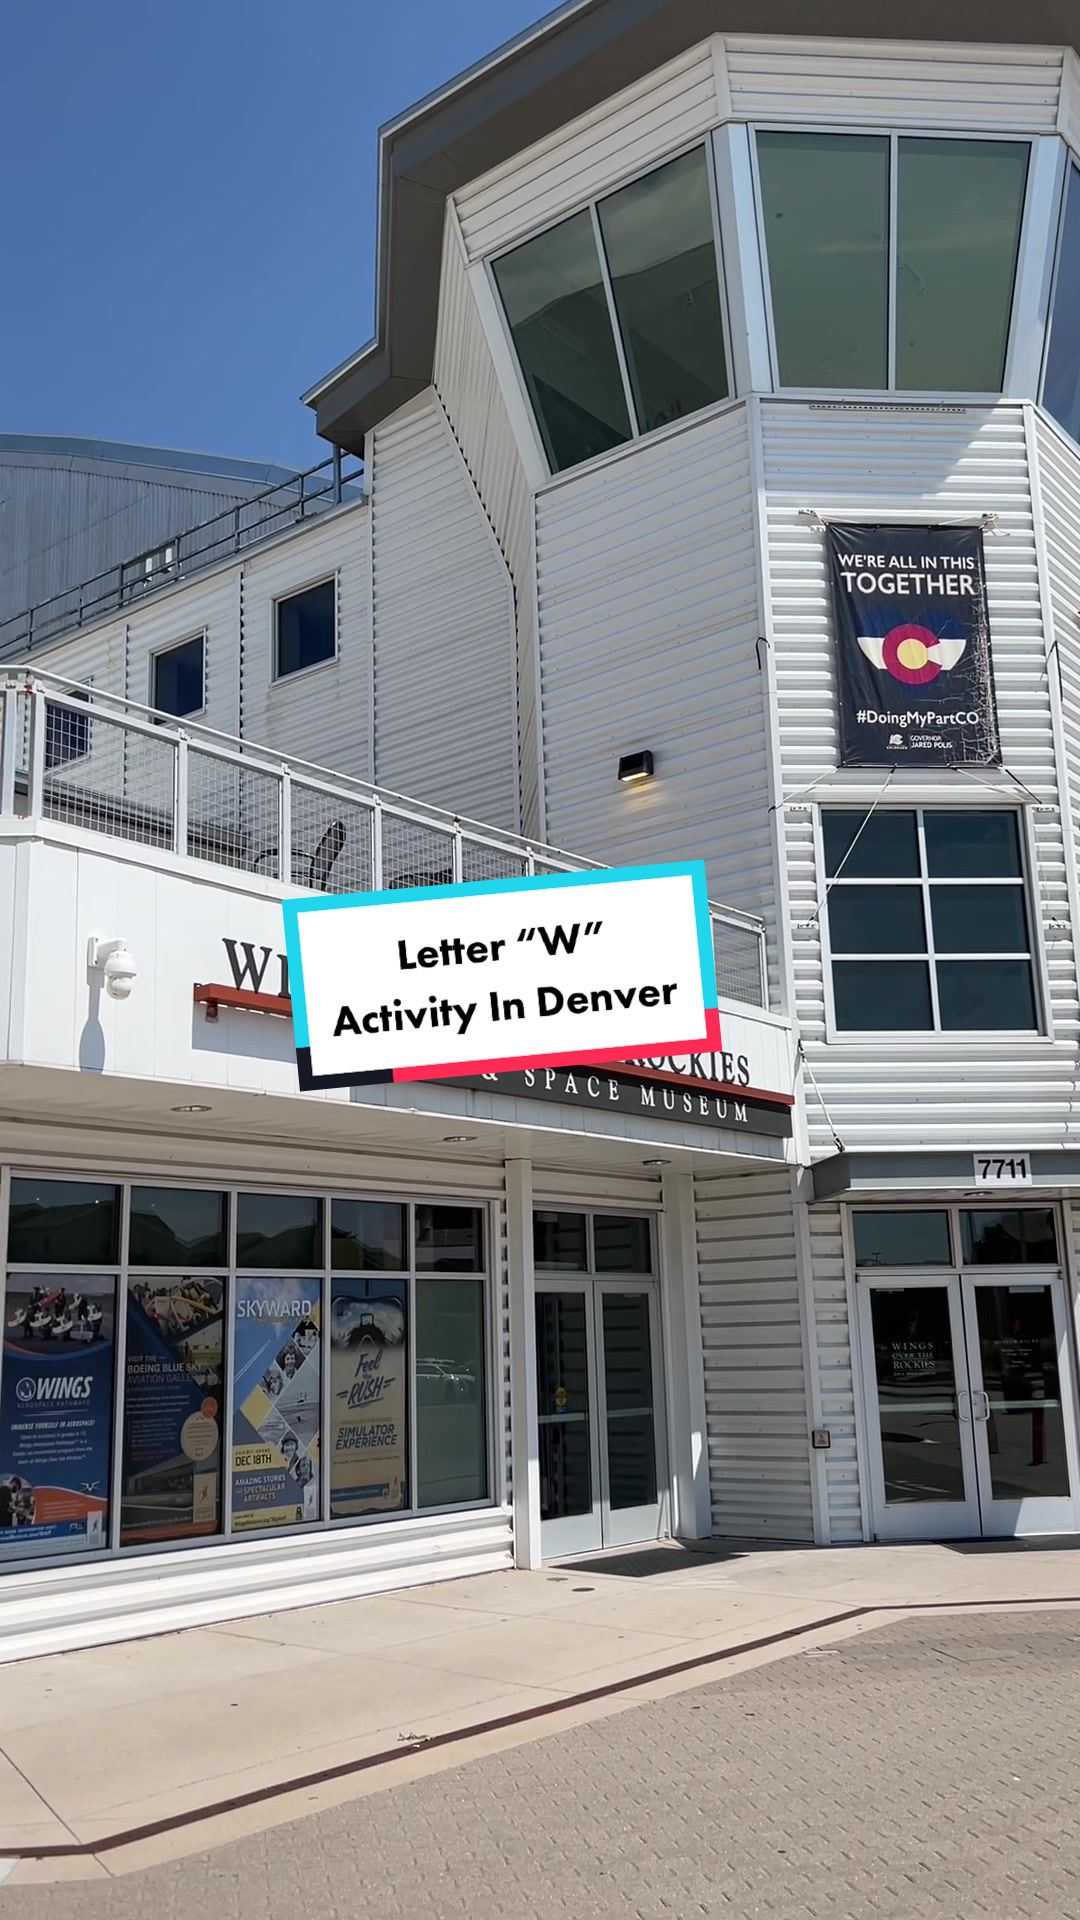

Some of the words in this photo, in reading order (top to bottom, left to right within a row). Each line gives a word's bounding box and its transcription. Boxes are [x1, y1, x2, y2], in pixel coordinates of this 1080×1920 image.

[838, 554, 885, 568] WE'RE
[889, 556, 917, 568] ALL
[921, 556, 937, 569] IN
[940, 556, 975, 570] THIS
[840, 571, 976, 596] TOGETHER
[856, 710, 979, 728] #DoingMyPartCO
[911, 741, 932, 749] JARED
[934, 741, 953, 749] POLIS
[525, 1068, 620, 1101] SPACE
[641, 1085, 748, 1122] MUSEUM
[977, 1158, 1027, 1179] 7711
[237, 1300, 312, 1318] SKYWARD
[892, 1341, 934, 1350] WINGS
[127, 1364, 161, 1374] BOEING
[162, 1362, 185, 1372] BLUE
[354, 1349, 383, 1377] Feel
[893, 1360, 936, 1369] ROCKIES
[127, 1374, 164, 1384] AVIATION
[36, 1376, 94, 1400] WINGS
[347, 1376, 384, 1406] RUSH
[338, 1424, 395, 1438] SIMULATOR
[335, 1434, 397, 1450] EXPERIENCE
[235, 1455, 251, 1467] DEC
[252, 1453, 272, 1465] 18TH
[235, 1476, 262, 1486] AMAZING
[263, 1474, 286, 1484] STORIES
[243, 1483, 287, 1495] SPECTACULAR
